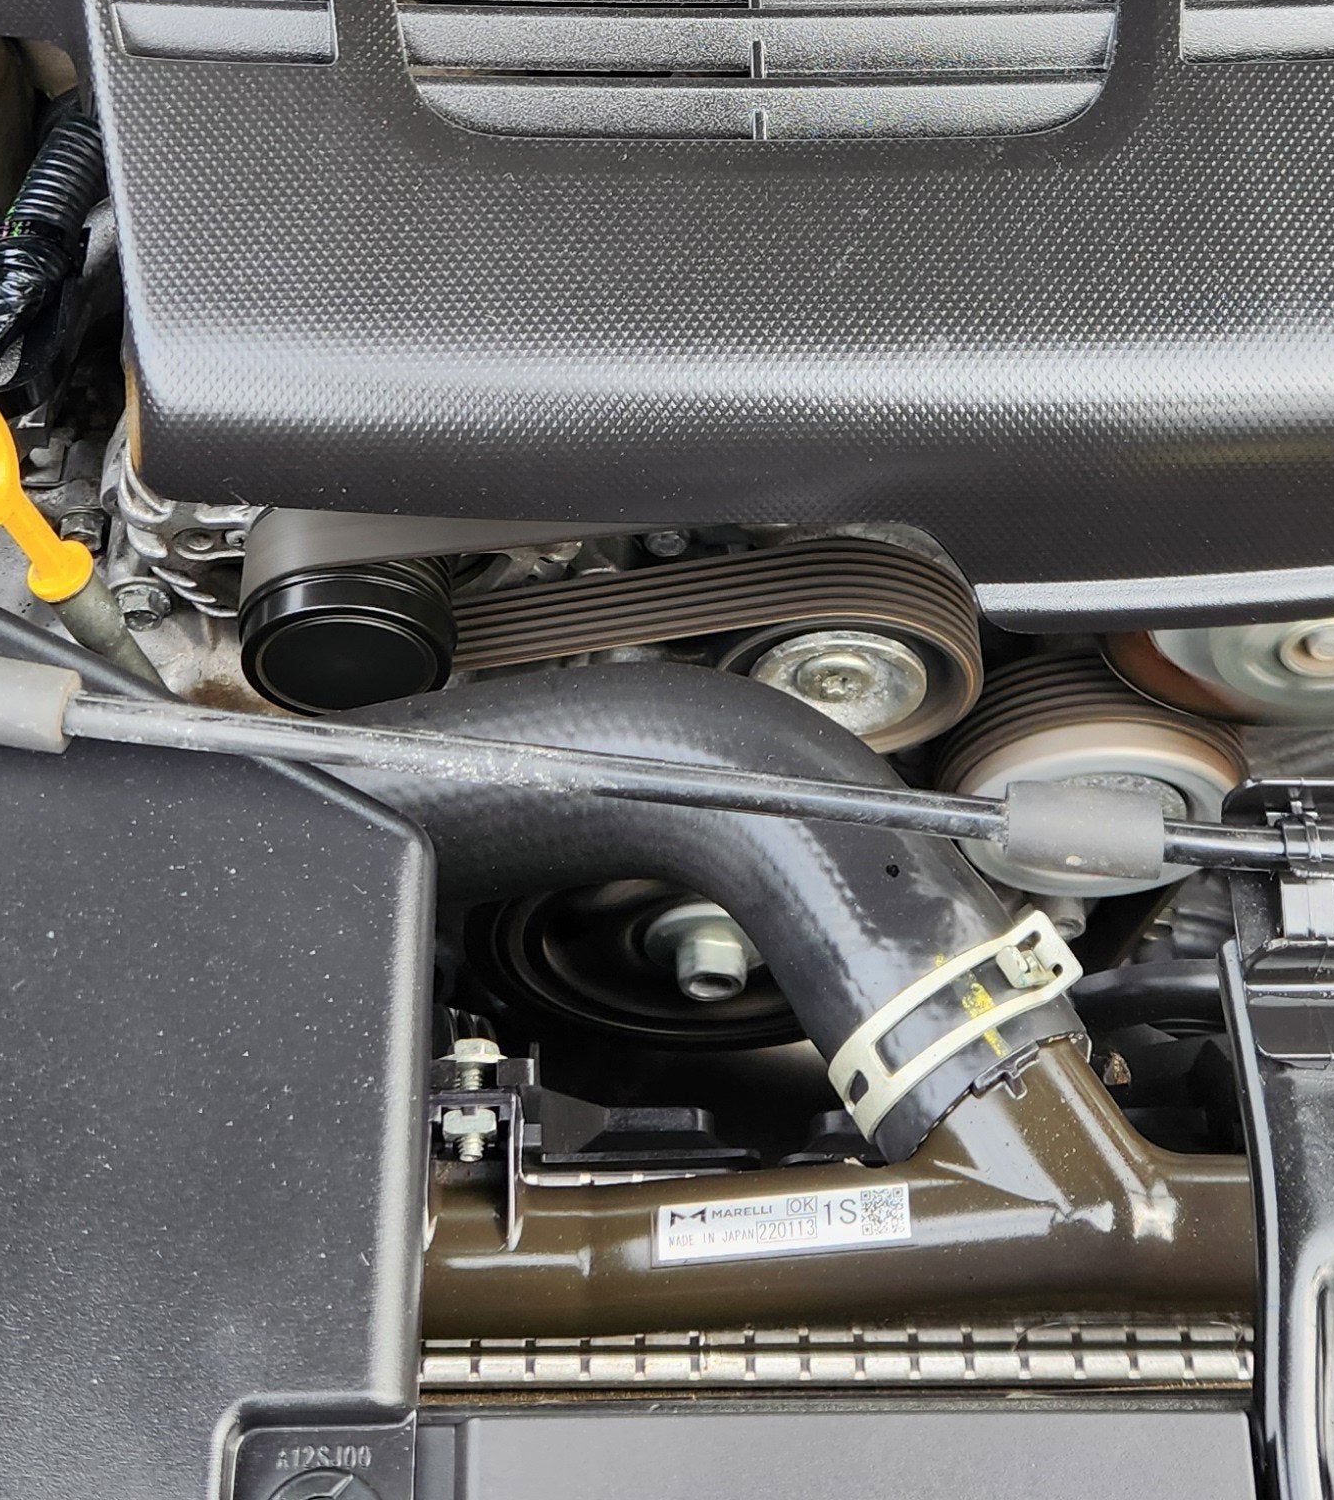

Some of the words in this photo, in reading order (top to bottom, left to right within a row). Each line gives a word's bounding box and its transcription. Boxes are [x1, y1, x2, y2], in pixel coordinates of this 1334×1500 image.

[711, 1205, 773, 1219] MARELLI
[789, 1199, 814, 1213] OK
[668, 1235, 695, 1247] MADE
[702, 1233, 715, 1244] IN
[721, 1229, 755, 1241] JAPAN
[758, 1220, 815, 1240] 220113
